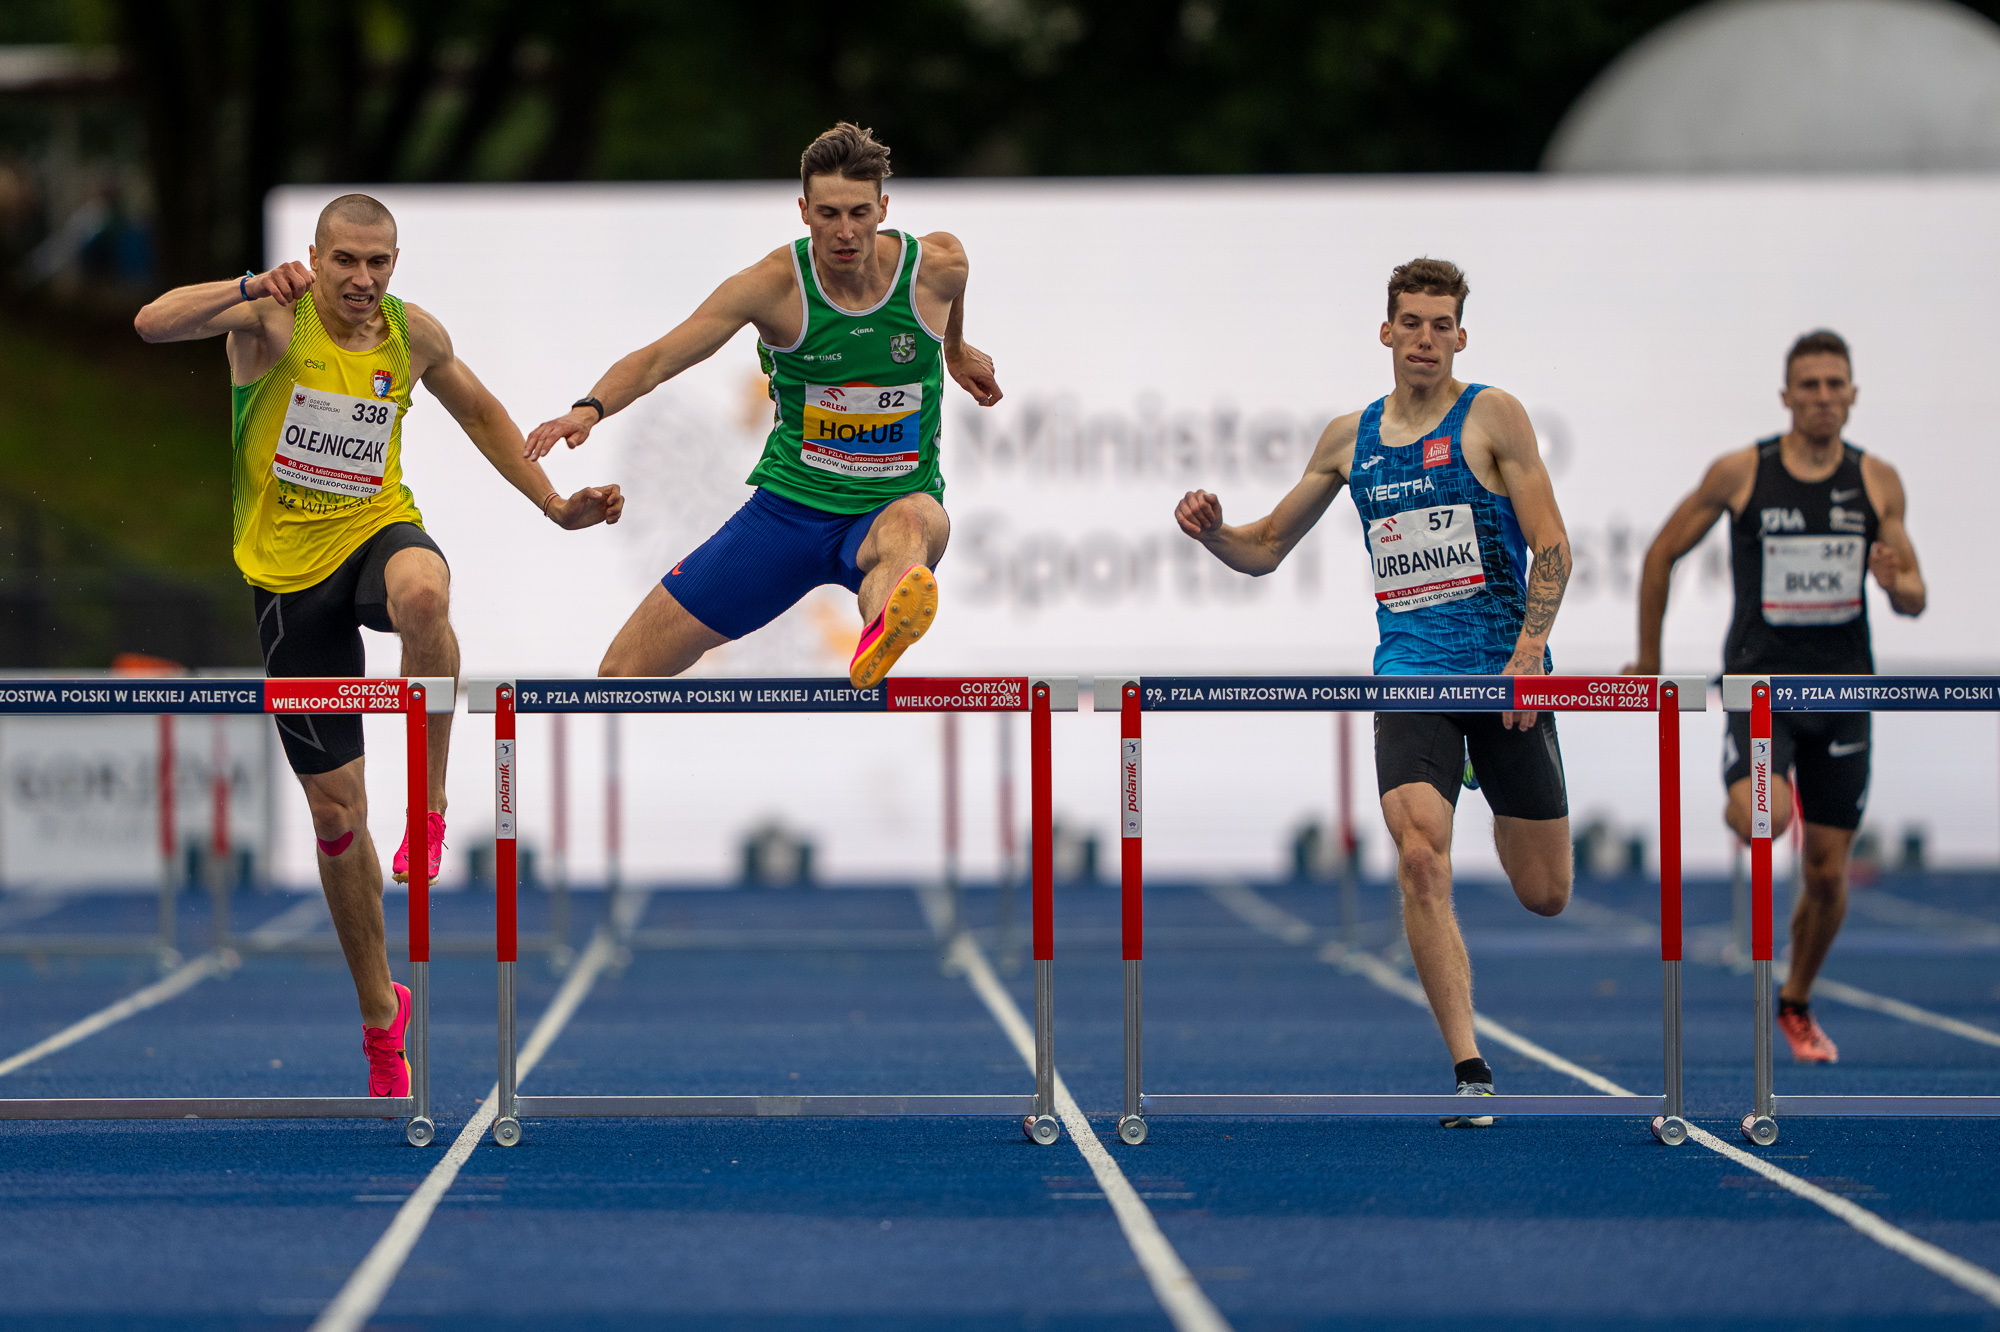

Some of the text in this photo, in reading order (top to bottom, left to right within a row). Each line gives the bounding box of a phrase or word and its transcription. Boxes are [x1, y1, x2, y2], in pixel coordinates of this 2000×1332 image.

[305, 359, 326, 371] esa
[308, 404, 340, 413] WIELKOPOLSKI
[820, 400, 847, 412] ORLEN
[878, 391, 905, 409] 82
[352, 403, 388, 425] 338
[820, 420, 904, 443] HOŁUB
[285, 425, 385, 463] OLEJNICZAK
[806, 454, 839, 468] GORZÓW
[840, 463, 894, 472] WIELKOPOLSKI
[817, 446, 904, 463] 99. PZLA Mistrzostwa Polski
[276, 467, 376, 494] GORZÓW WIELKOPOLSKI 2023
[288, 460, 372, 483] 99. PZLA Mistrzostwa Polski
[1366, 476, 1435, 502] VECTRA
[1428, 509, 1454, 531] 57
[1380, 534, 1402, 544] ORLEN
[1377, 542, 1476, 578] URBANIAK
[1398, 589, 1412, 597] PZLA
[1412, 583, 1451, 594] Mistrzostwa
[1452, 578, 1471, 587] Polski
[1785, 572, 1842, 592] BUCK
[1384, 600, 1411, 609] ORZÓW
[1412, 591, 1464, 604] WIELKOPOLSKI
[338, 683, 400, 696] GORZÓW
[960, 680, 1021, 694] GORZÓW
[1146, 687, 1506, 701] 99. PZLA MISTRZOSTWA POLSKI W LEKKIEJ ATLETYCE
[1588, 680, 1649, 694] GORZÓW
[1776, 688, 1993, 700] 99. PZLA MISTRZOSTWA POLSKI
[61, 690, 110, 703] POLSKI
[110, 690, 128, 703] W
[132, 690, 185, 703] LEKKIEJ
[189, 690, 256, 703] ATLETYCE
[272, 698, 400, 709] WIELKOPOLSKI 2023
[521, 690, 879, 704] 99. PZLA MISTRZOSTWA POLSKI W LEKKIEJ ATLETYCE
[895, 696, 1021, 707] WIELKOPOLSKI 2023
[1522, 694, 1649, 708] WIELKOPOLSKI 2023
[499, 763, 512, 814] polanik
[1126, 762, 1139, 812] polanik
[1755, 762, 1768, 813] polanik
